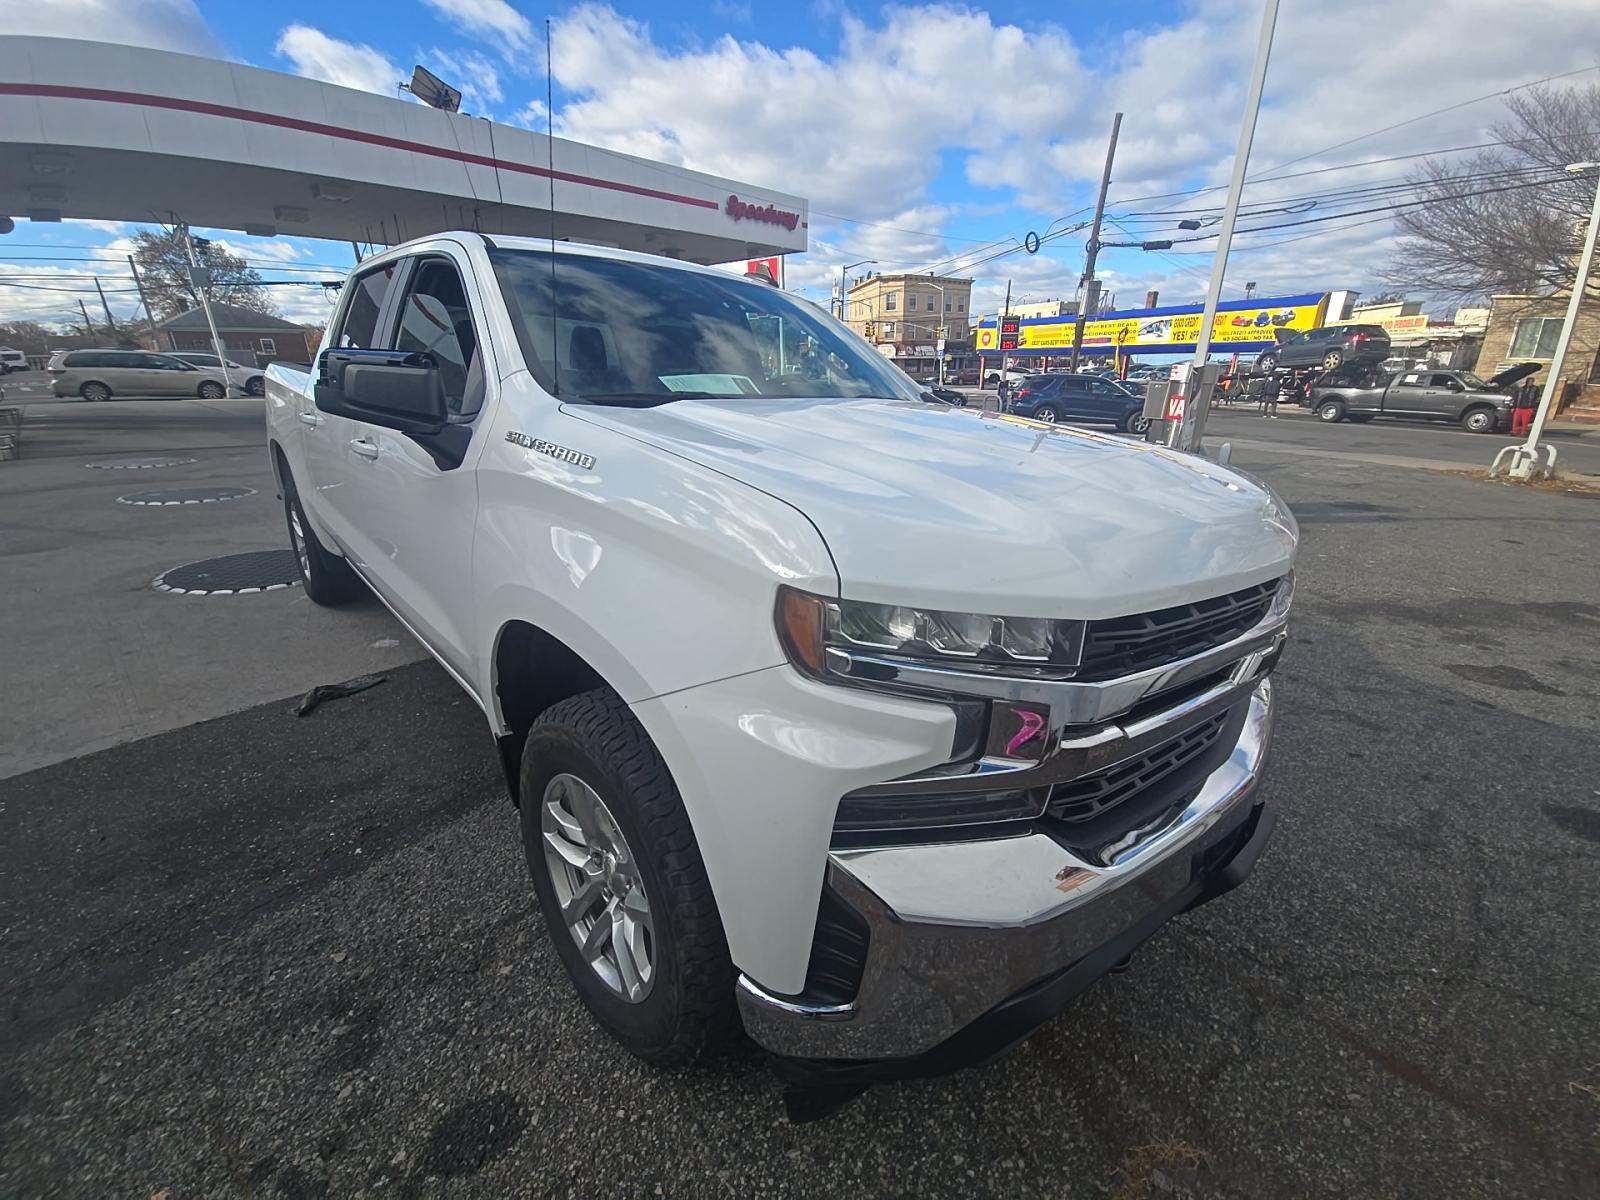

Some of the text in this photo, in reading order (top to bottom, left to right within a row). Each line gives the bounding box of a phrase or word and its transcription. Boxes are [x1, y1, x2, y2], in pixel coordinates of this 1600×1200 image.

[725, 194, 800, 232] Speedway
[1172, 330, 1188, 341] YES!
[504, 430, 597, 471] SILVERADO
